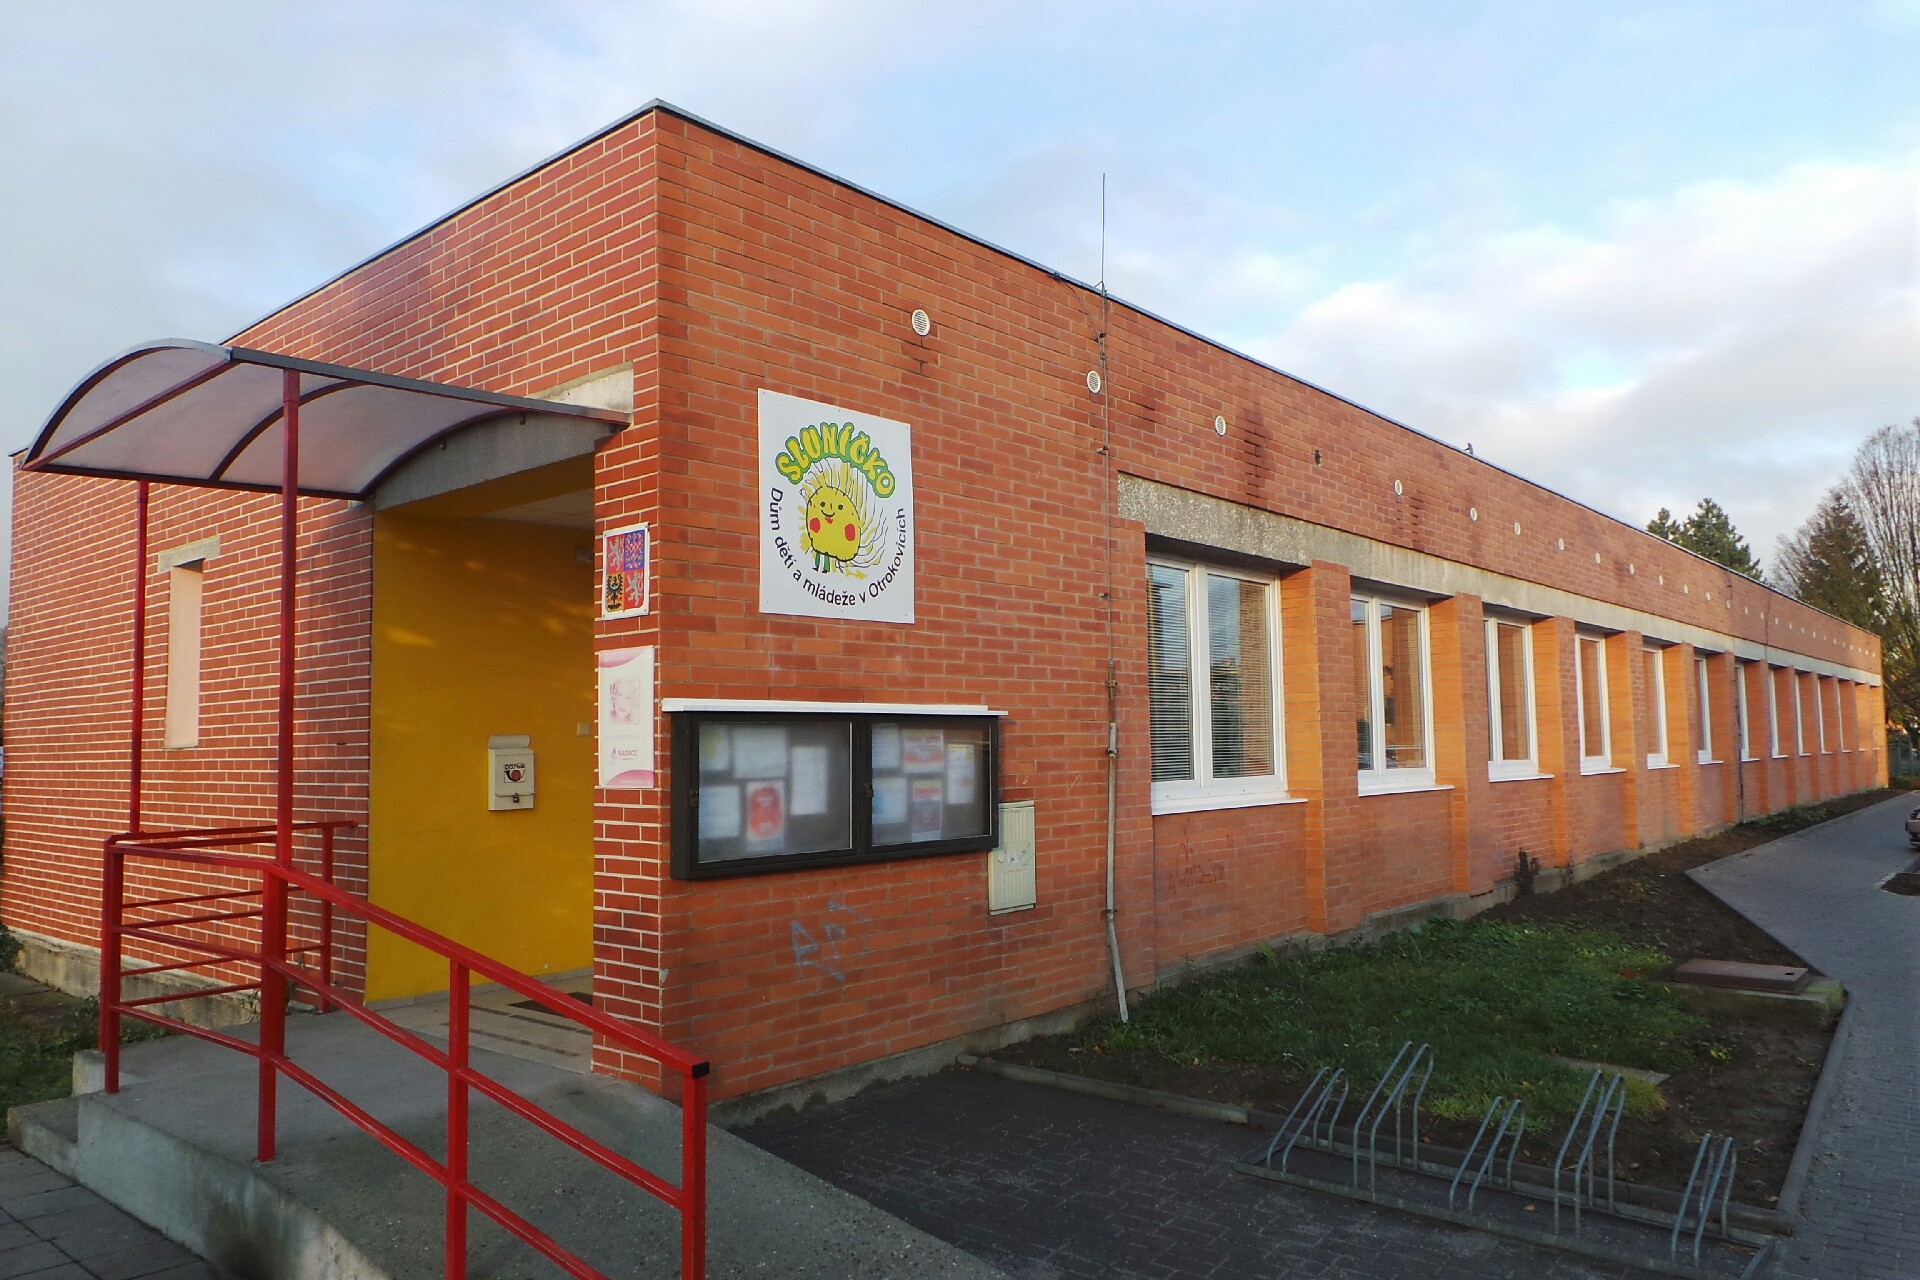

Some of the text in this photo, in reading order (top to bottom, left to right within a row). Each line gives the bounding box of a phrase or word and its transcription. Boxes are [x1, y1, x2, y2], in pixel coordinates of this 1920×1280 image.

[769, 487, 784, 531] Dům
[774, 536, 798, 569] dětí
[792, 569, 802, 582] a
[802, 578, 856, 606] mládeže
[858, 591, 866, 603] v
